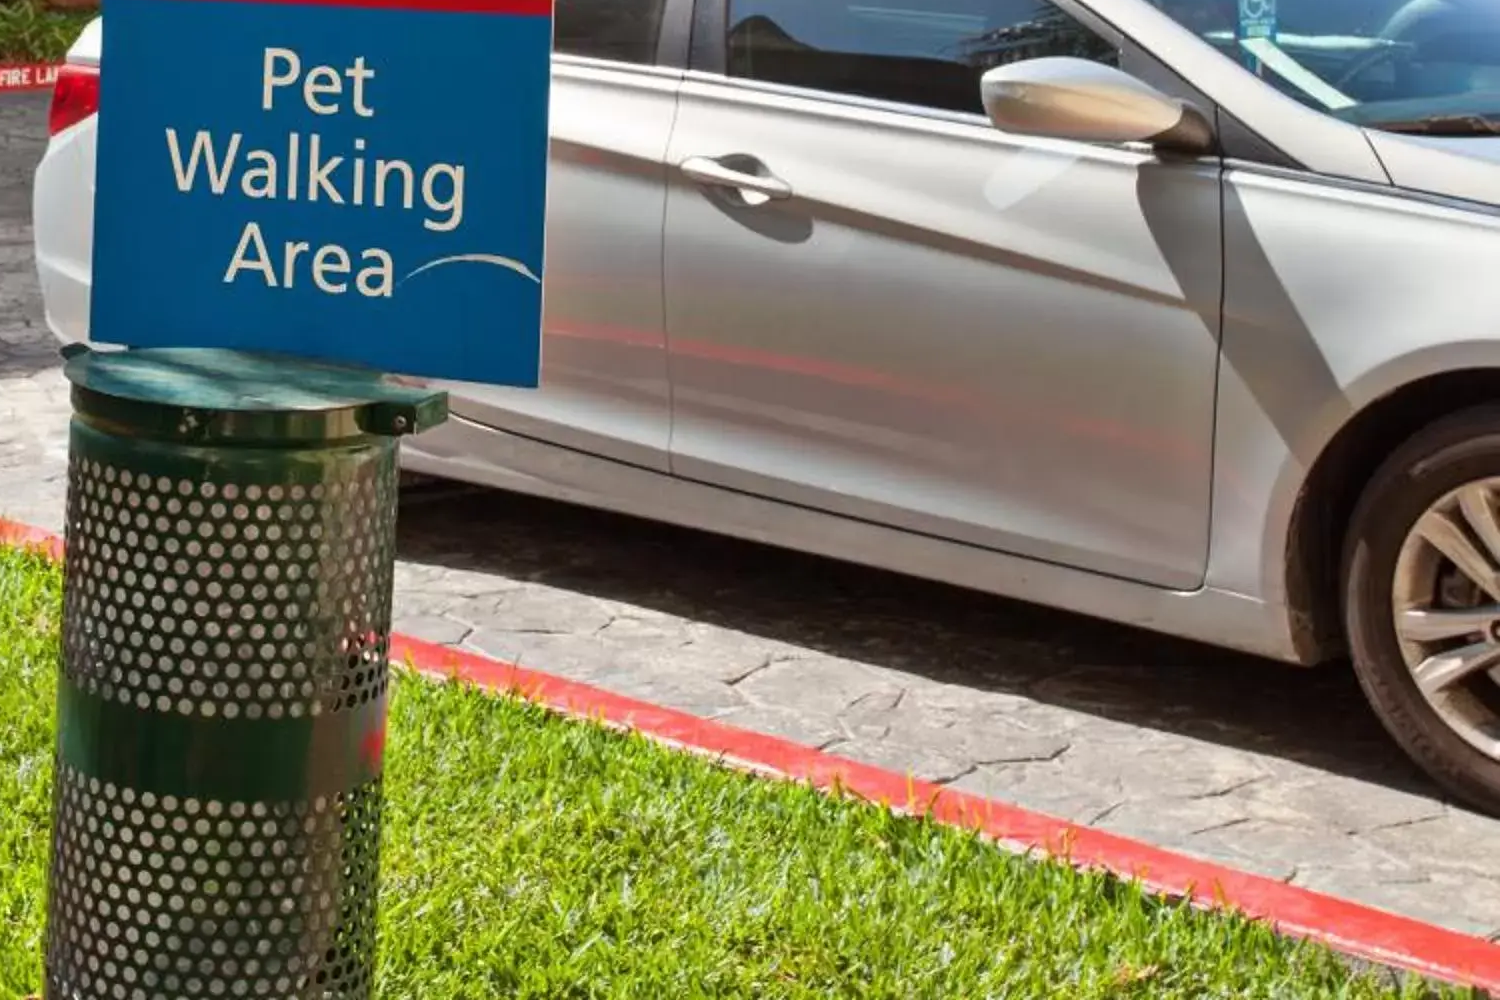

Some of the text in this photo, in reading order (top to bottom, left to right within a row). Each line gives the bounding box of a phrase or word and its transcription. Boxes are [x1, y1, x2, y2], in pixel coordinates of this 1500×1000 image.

[35, 66, 59, 85] LA
[262, 46, 376, 117] Pet
[165, 127, 465, 231] Walking
[223, 221, 395, 298] Area
